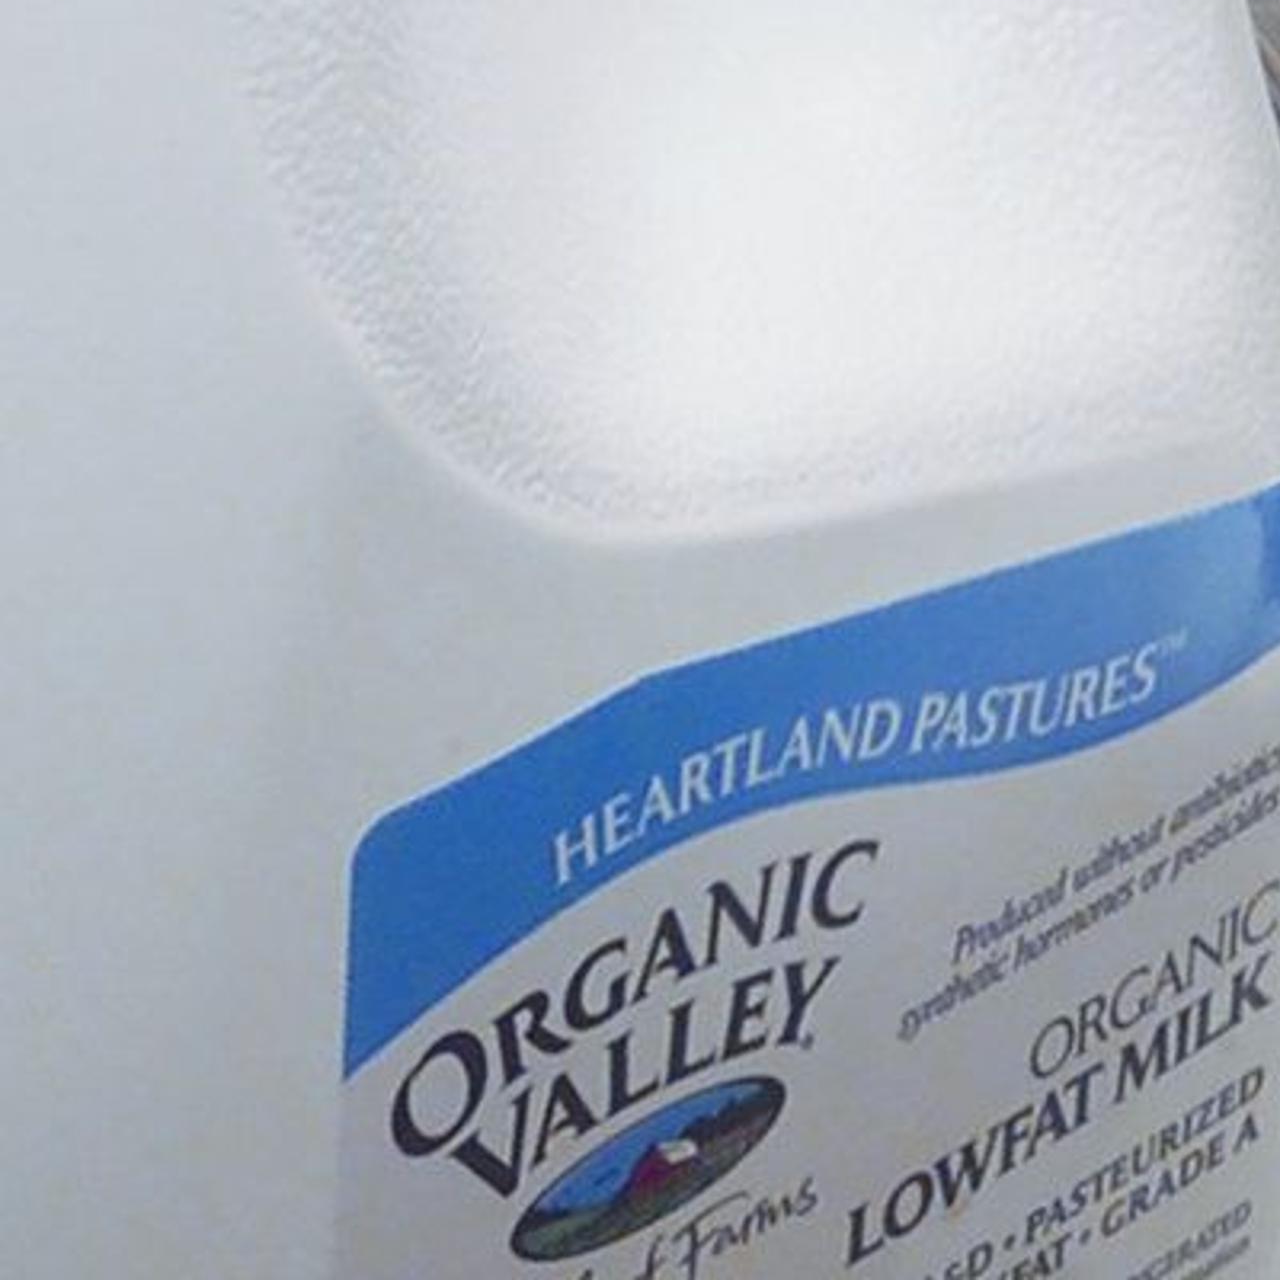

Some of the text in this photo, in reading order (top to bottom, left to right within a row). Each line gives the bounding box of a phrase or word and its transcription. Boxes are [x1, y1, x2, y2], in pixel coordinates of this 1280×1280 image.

[552, 649, 1160, 887] HEARTLAND PASTURES
[951, 865, 1069, 967] Produced
[1072, 816, 1166, 892] without
[1013, 876, 1136, 972] hormones
[1169, 786, 1280, 884] pesticides
[1027, 878, 1280, 1081] ORGANIC
[389, 838, 881, 1159] ORGANIC
[449, 954, 842, 1201] VALLEY
[845, 1070, 1105, 1268] LOWFAT
[1114, 953, 1276, 1121] MILK
[1025, 1064, 1266, 1247] PASTEURIZED
[1099, 1127, 1226, 1240] GRADE
[1231, 1111, 1262, 1153] A
